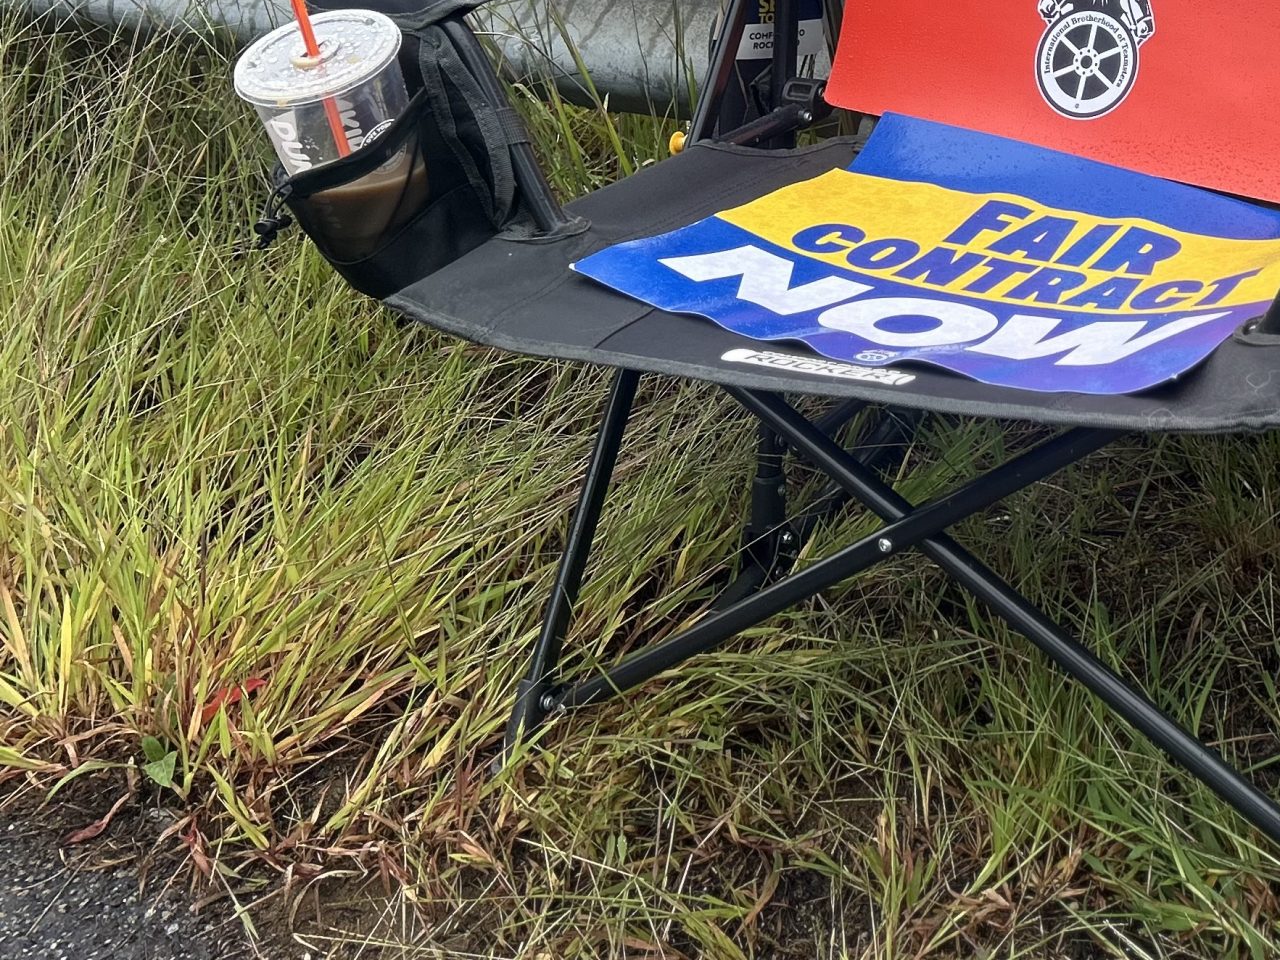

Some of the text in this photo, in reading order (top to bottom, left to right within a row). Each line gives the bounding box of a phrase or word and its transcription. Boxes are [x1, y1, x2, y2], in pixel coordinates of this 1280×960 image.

[1043, 14, 1129, 88] International Brotherhood of Teamsters
[790, 222, 1261, 312] CONTRACT
[944, 198, 1182, 276] FAIR
[658, 244, 1233, 367] NOW
[744, 353, 888, 379] ROCKER
